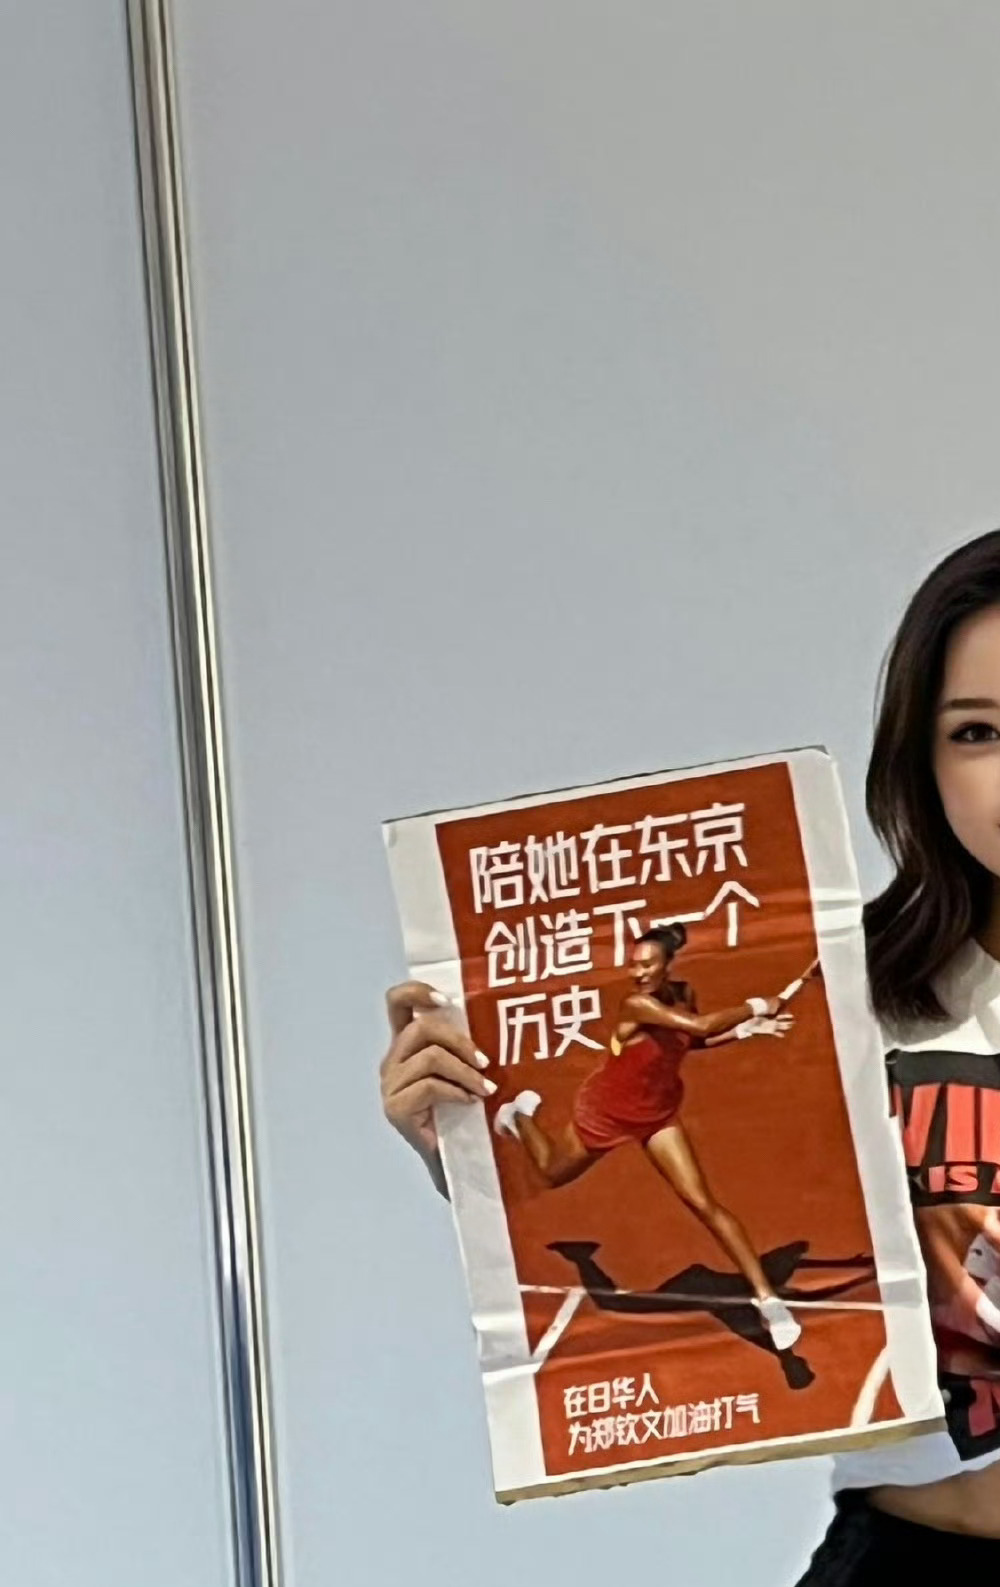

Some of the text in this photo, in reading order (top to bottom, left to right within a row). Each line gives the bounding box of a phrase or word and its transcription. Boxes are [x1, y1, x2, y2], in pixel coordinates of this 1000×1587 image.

[469, 802, 748, 914] 陪她在东京
[484, 880, 760, 988] 创造下一个
[497, 985, 606, 1066] 历史
[563, 1372, 660, 1419] 在日华人
[568, 1393, 761, 1456] 为郑钦文加油打气
